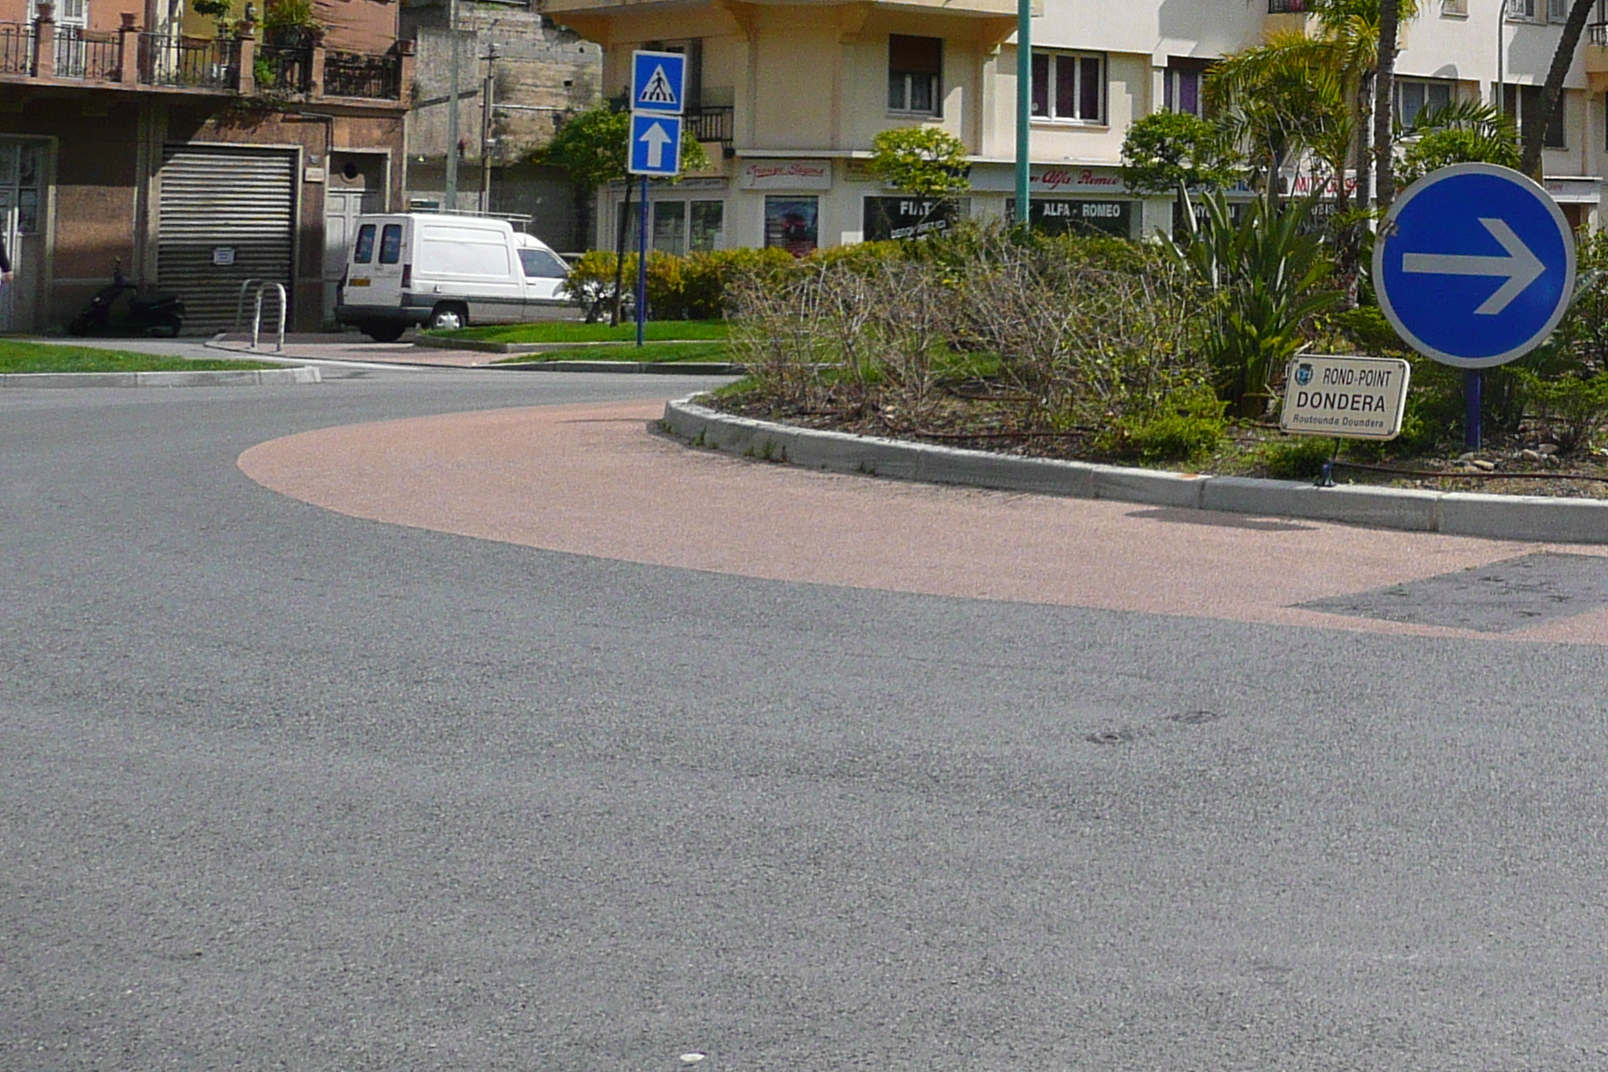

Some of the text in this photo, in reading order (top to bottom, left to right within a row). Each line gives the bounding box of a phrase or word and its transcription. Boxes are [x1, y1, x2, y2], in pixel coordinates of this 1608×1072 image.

[1041, 169, 1071, 189] Alfa
[1077, 169, 1119, 186] Romeo
[900, 201, 932, 216] FIAT
[1043, 203, 1070, 217] ALFA
[1082, 203, 1121, 218] ROMEO
[1322, 368, 1392, 387] ROND-POINT
[1296, 391, 1386, 413] DONDERA
[1342, 416, 1384, 428] Doundera
